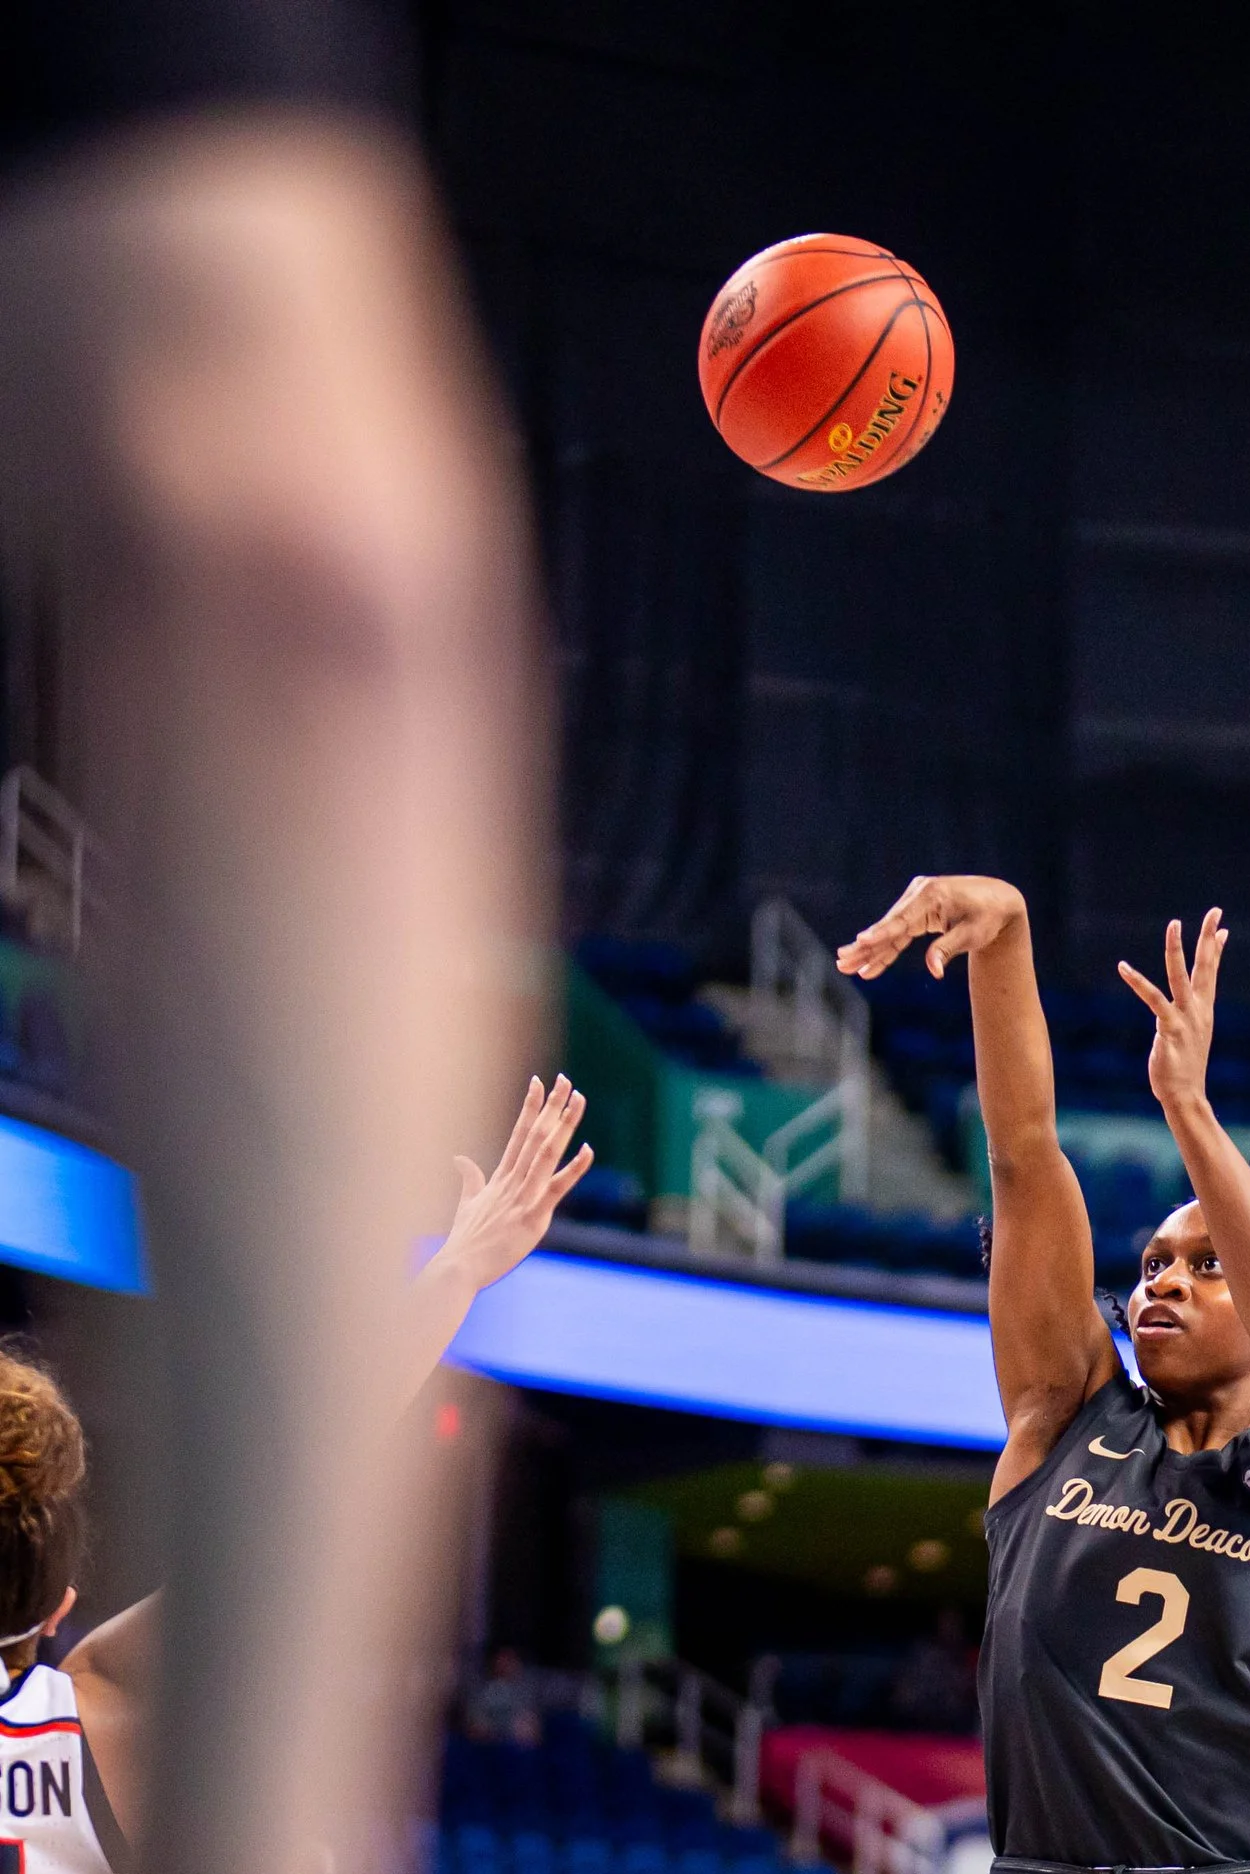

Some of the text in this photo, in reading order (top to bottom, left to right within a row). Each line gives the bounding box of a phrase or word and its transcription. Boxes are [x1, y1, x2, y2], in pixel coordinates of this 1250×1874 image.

[1046, 1478, 1150, 1536] Demon
[1098, 1567, 1190, 1709] 2
[0, 1760, 73, 1817] ON
